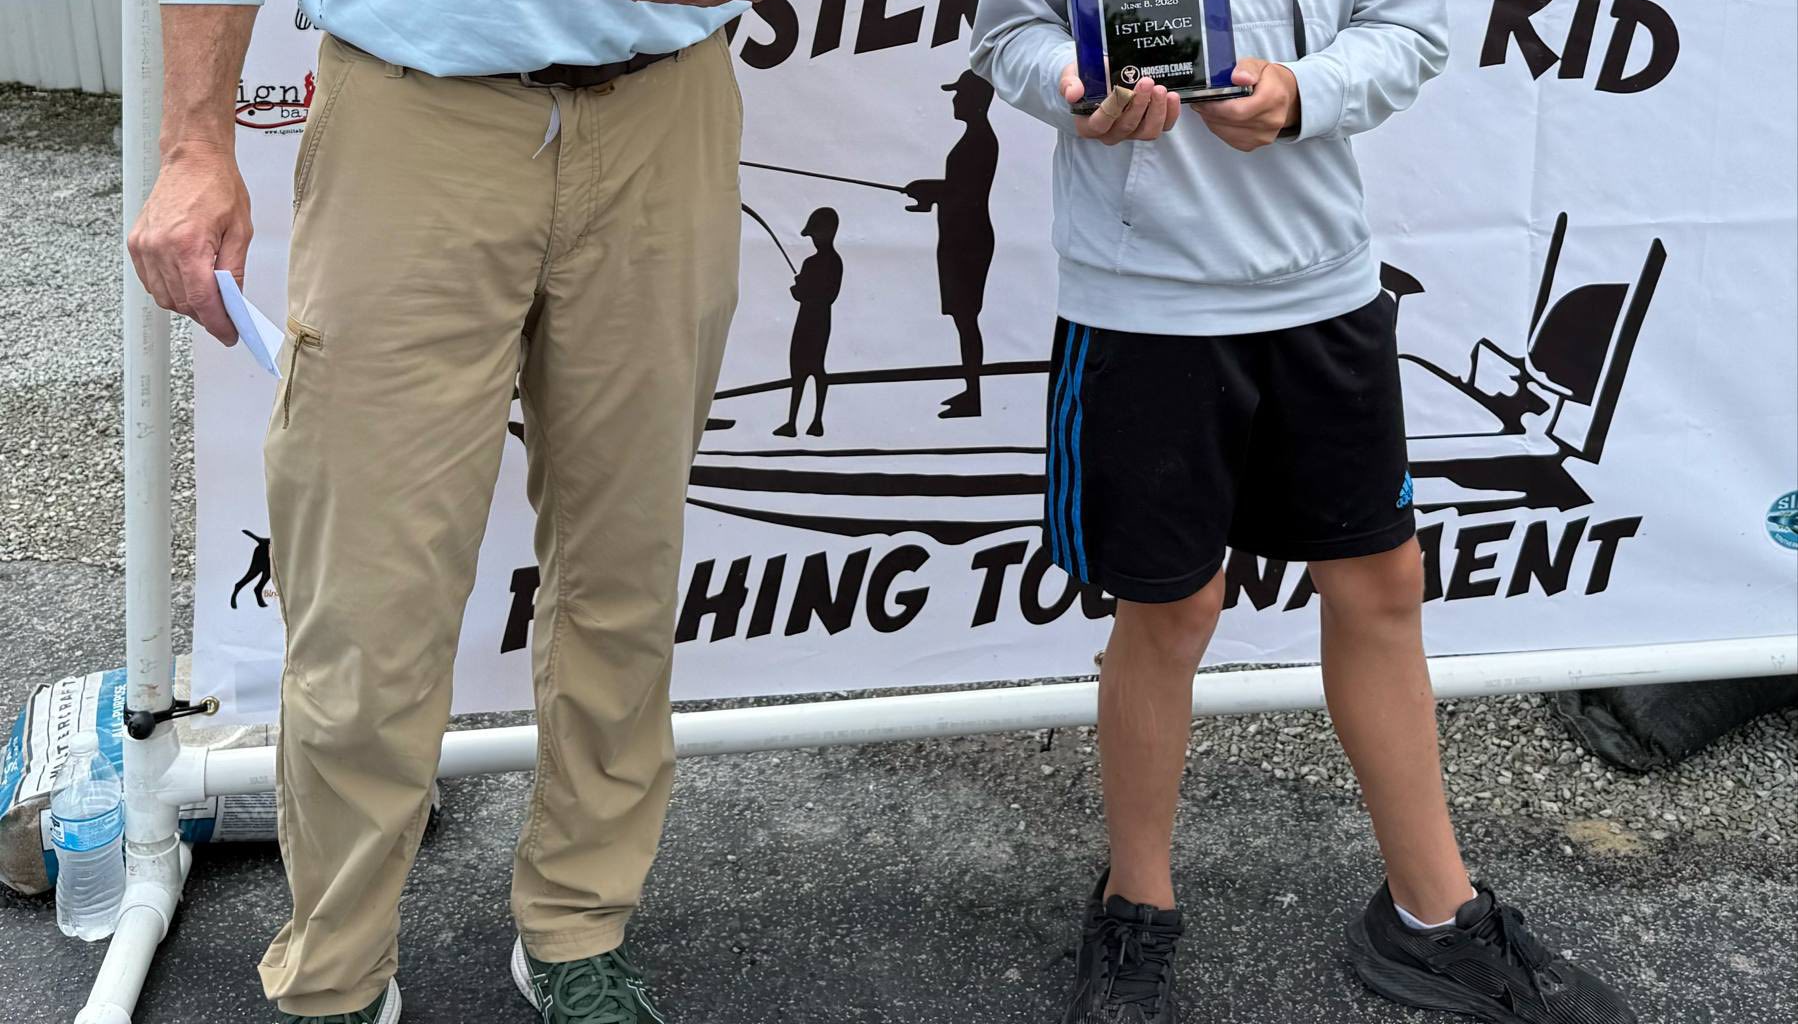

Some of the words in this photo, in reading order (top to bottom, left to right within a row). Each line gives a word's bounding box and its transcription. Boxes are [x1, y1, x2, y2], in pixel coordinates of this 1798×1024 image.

[1115, 23, 1141, 35] 1ST
[1145, 17, 1192, 33] PLACE
[1133, 35, 1174, 49] TEAM
[236, 77, 314, 110] ign
[500, 544, 931, 654] FHING
[971, 516, 1642, 628] TONENT
